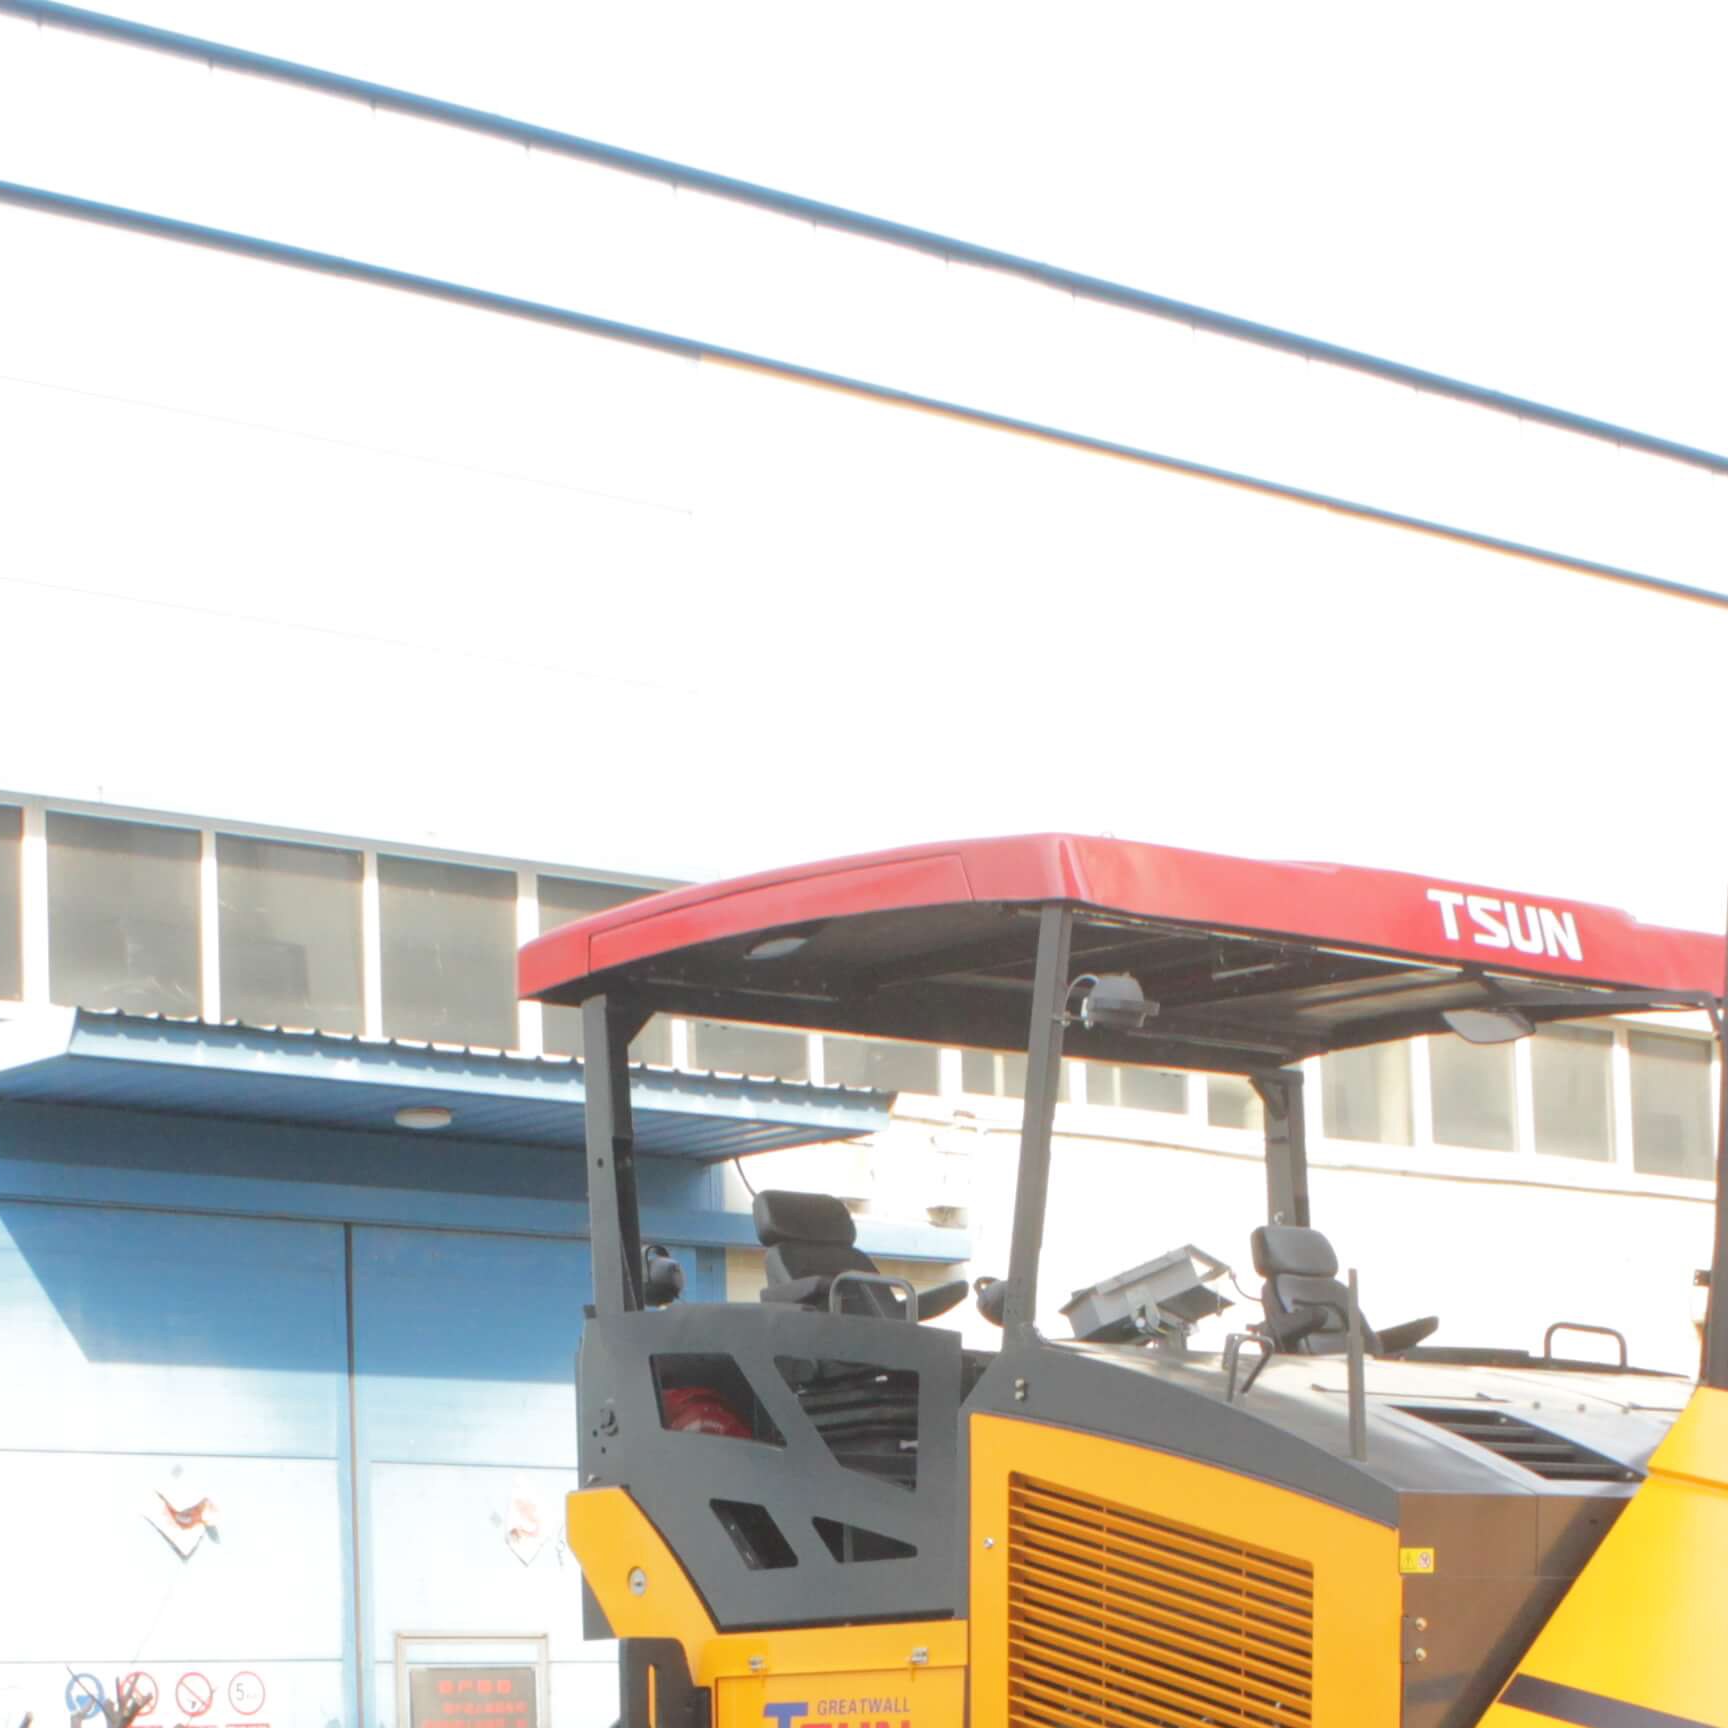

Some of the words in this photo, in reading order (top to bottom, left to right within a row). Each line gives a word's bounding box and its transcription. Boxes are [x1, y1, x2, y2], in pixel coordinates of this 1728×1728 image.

[1426, 888, 1583, 961] TSUN
[235, 1682, 245, 1701] 5
[817, 1696, 911, 1716] GREATWALL
